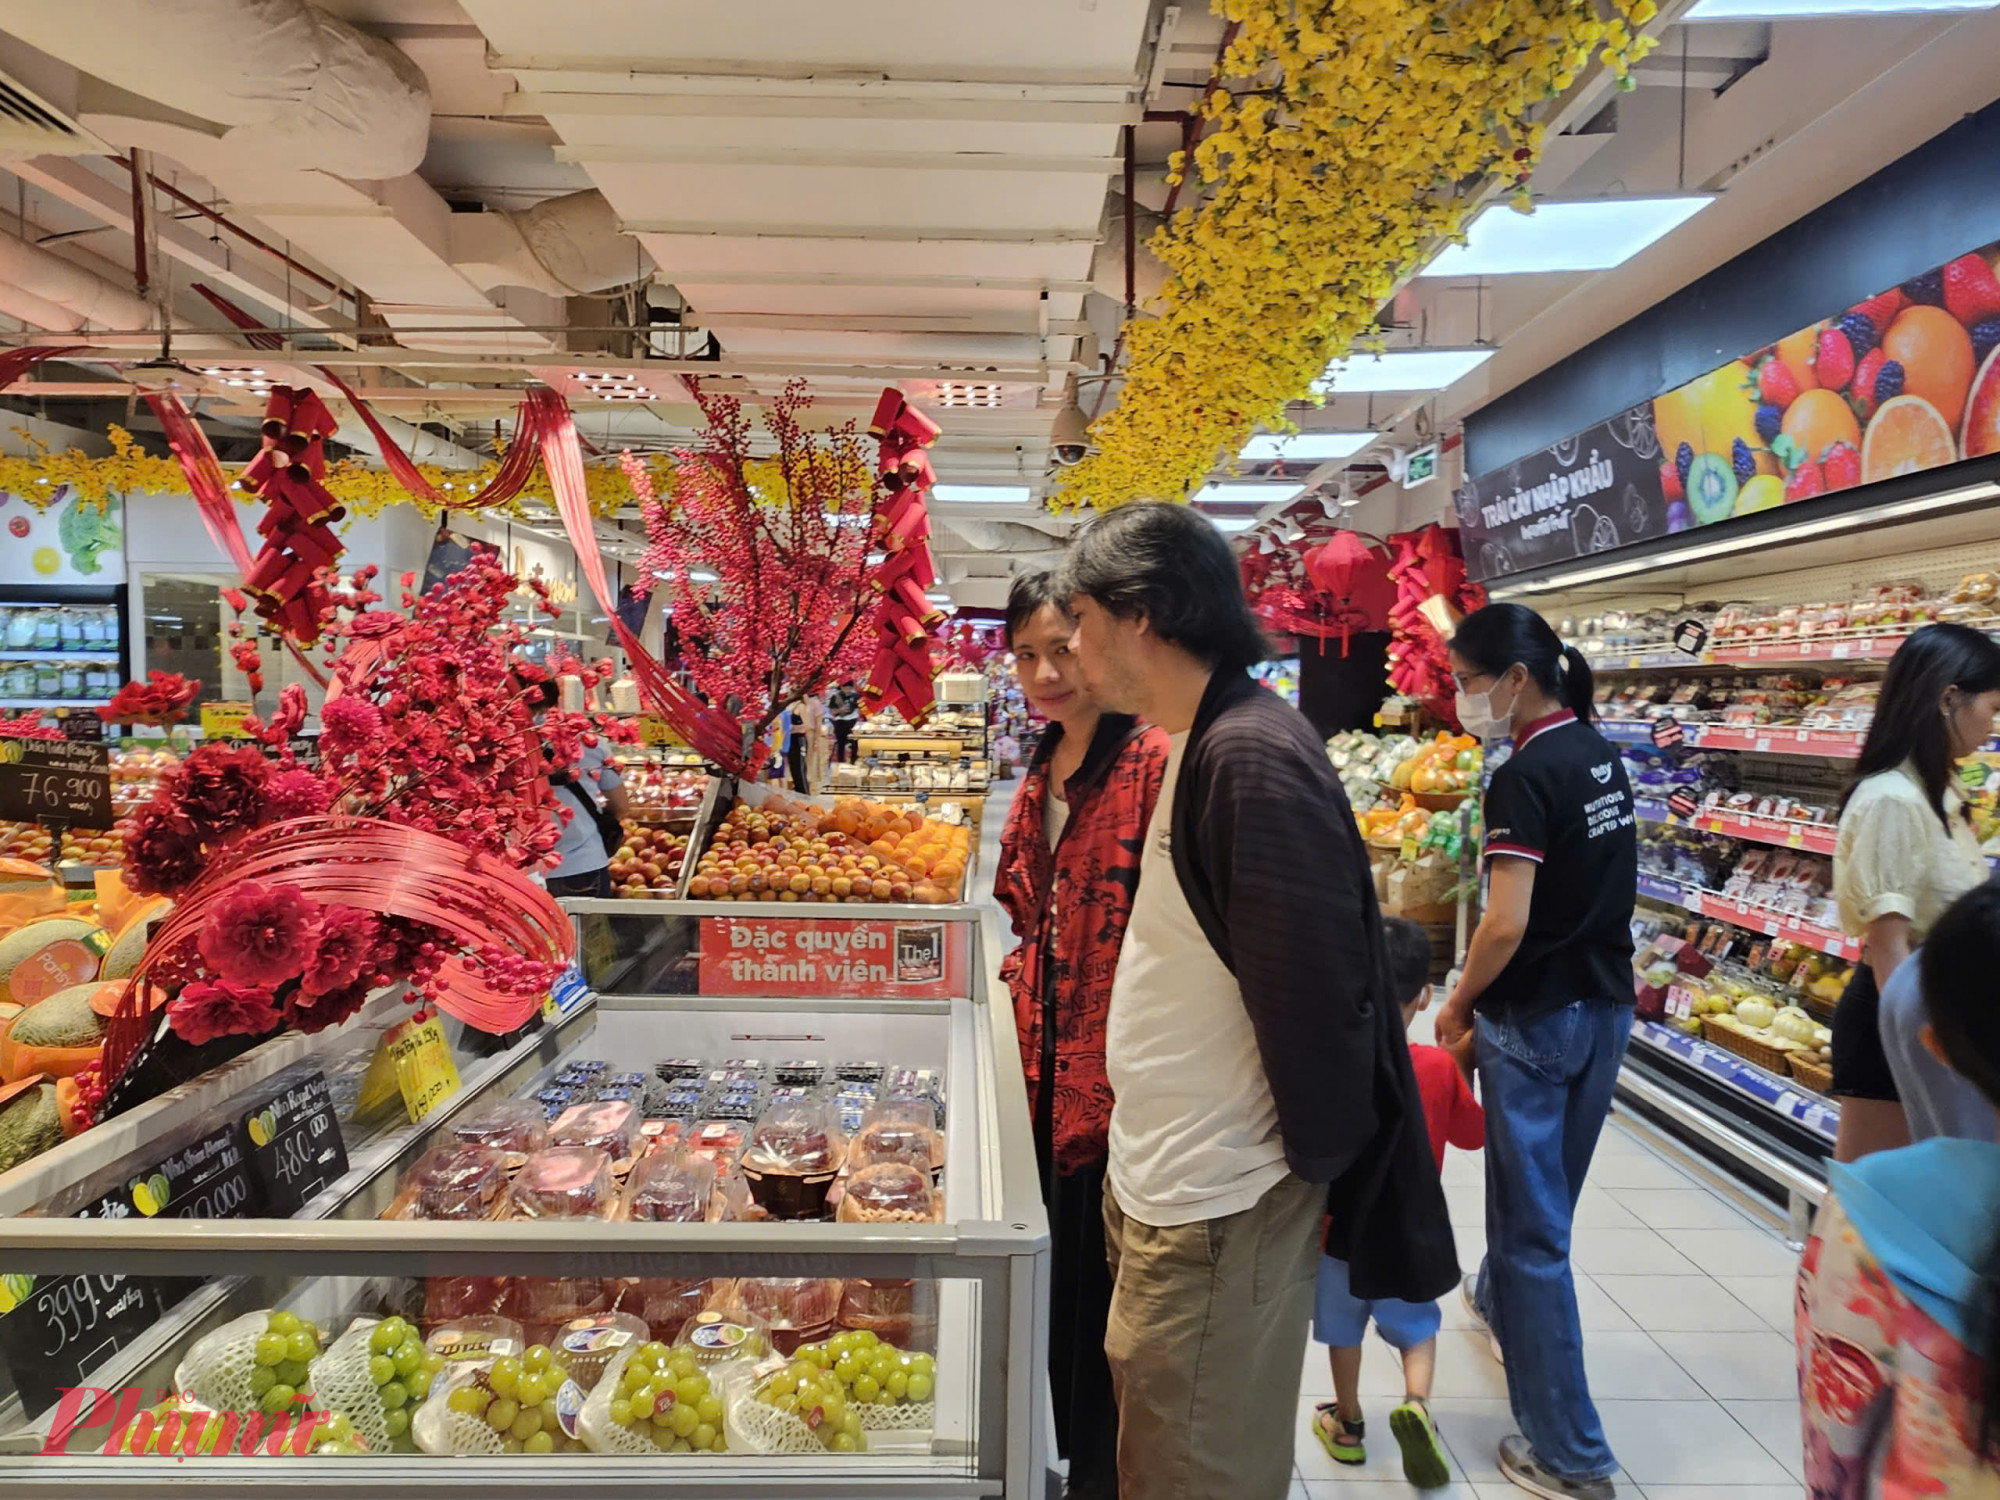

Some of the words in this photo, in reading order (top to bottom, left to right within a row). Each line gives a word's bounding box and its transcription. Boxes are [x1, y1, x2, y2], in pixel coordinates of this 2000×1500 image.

[20, 772, 102, 807] 76.900
[731, 925, 787, 955] Đặc
[795, 922, 886, 956] quyền
[36, 951, 75, 987] Pansy
[731, 956, 817, 982] thành
[825, 960, 887, 982] viên
